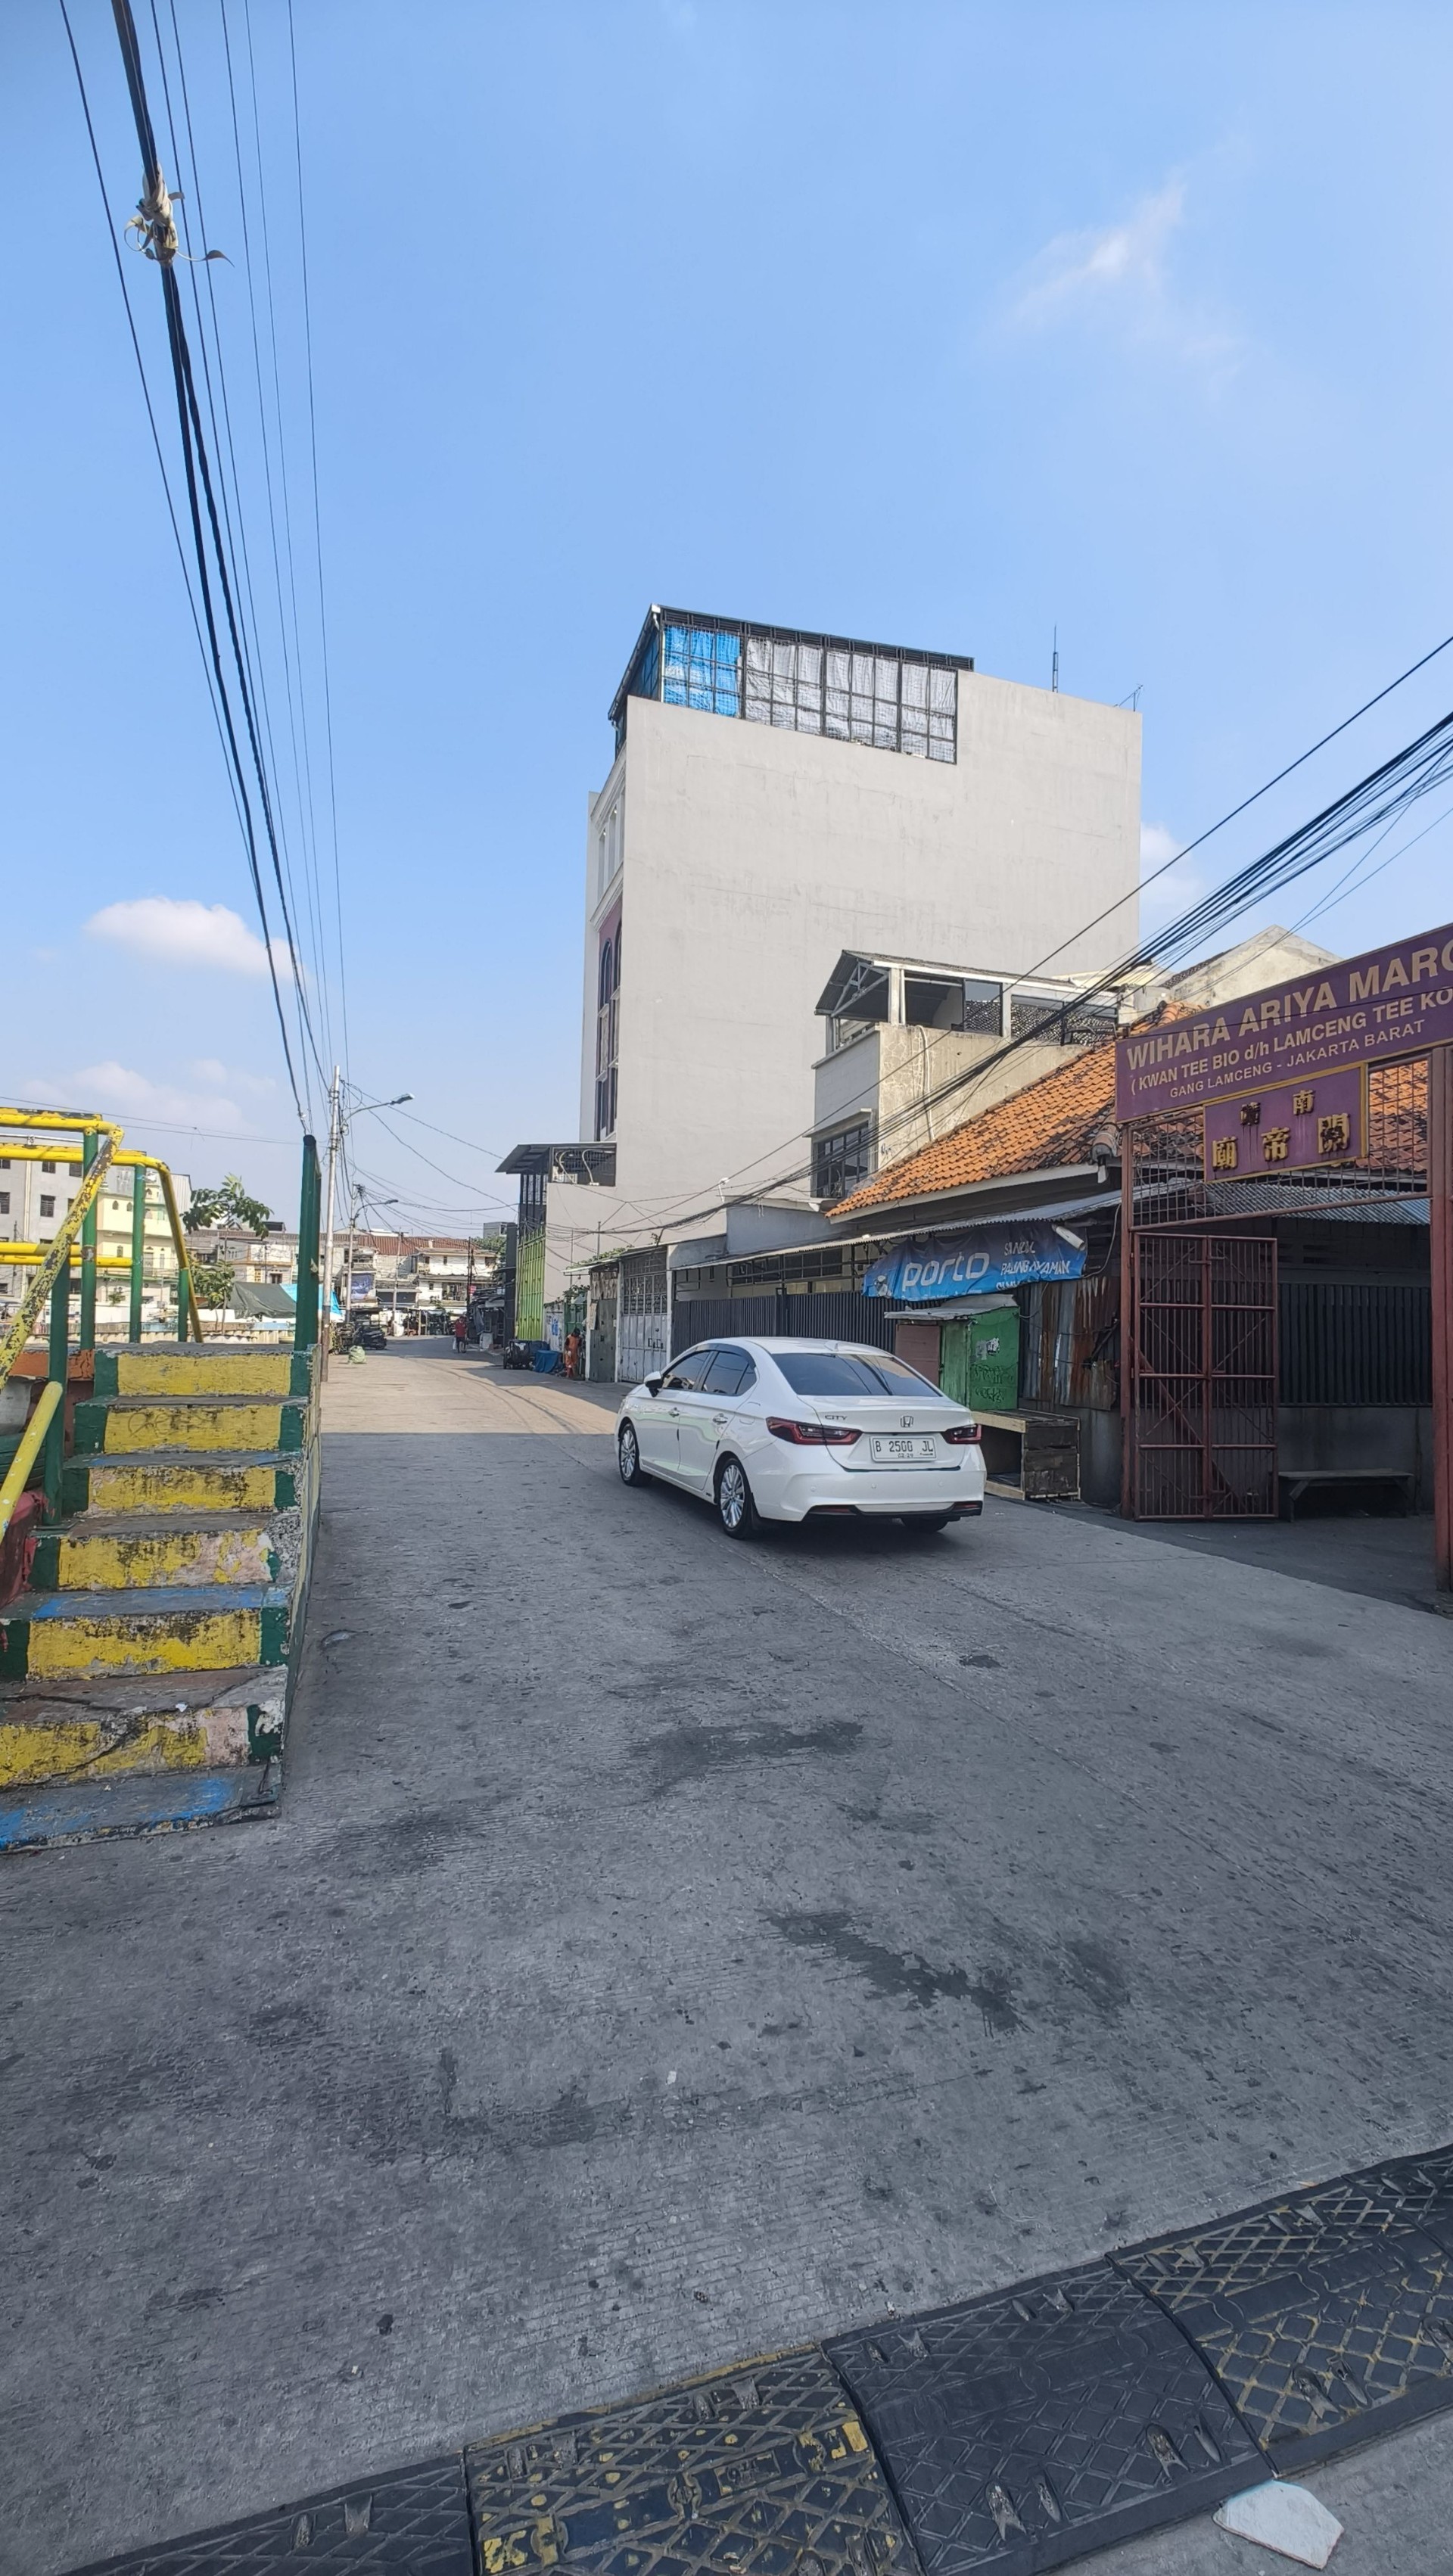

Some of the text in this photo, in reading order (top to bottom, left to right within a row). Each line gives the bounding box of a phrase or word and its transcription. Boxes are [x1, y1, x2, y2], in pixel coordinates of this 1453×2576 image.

[1127, 1017, 1230, 1070] WIHARA
[1238, 982, 1337, 1036] ARIYA
[1170, 1080, 1204, 1097] GANG
[1208, 1062, 1272, 1088] LAMCENG
[1287, 1039, 1359, 1067] JAKARTA
[1364, 1019, 1425, 1047] BARAT
[1181, 1058, 1209, 1078] TEE
[1212, 1050, 1240, 1069] BIO
[1244, 1041, 1269, 1060] d/h
[1274, 1012, 1366, 1052] LAMCENG
[1373, 997, 1414, 1022] TEE
[875, 1440, 882, 1452] B
[888, 1440, 913, 1452] 2500
